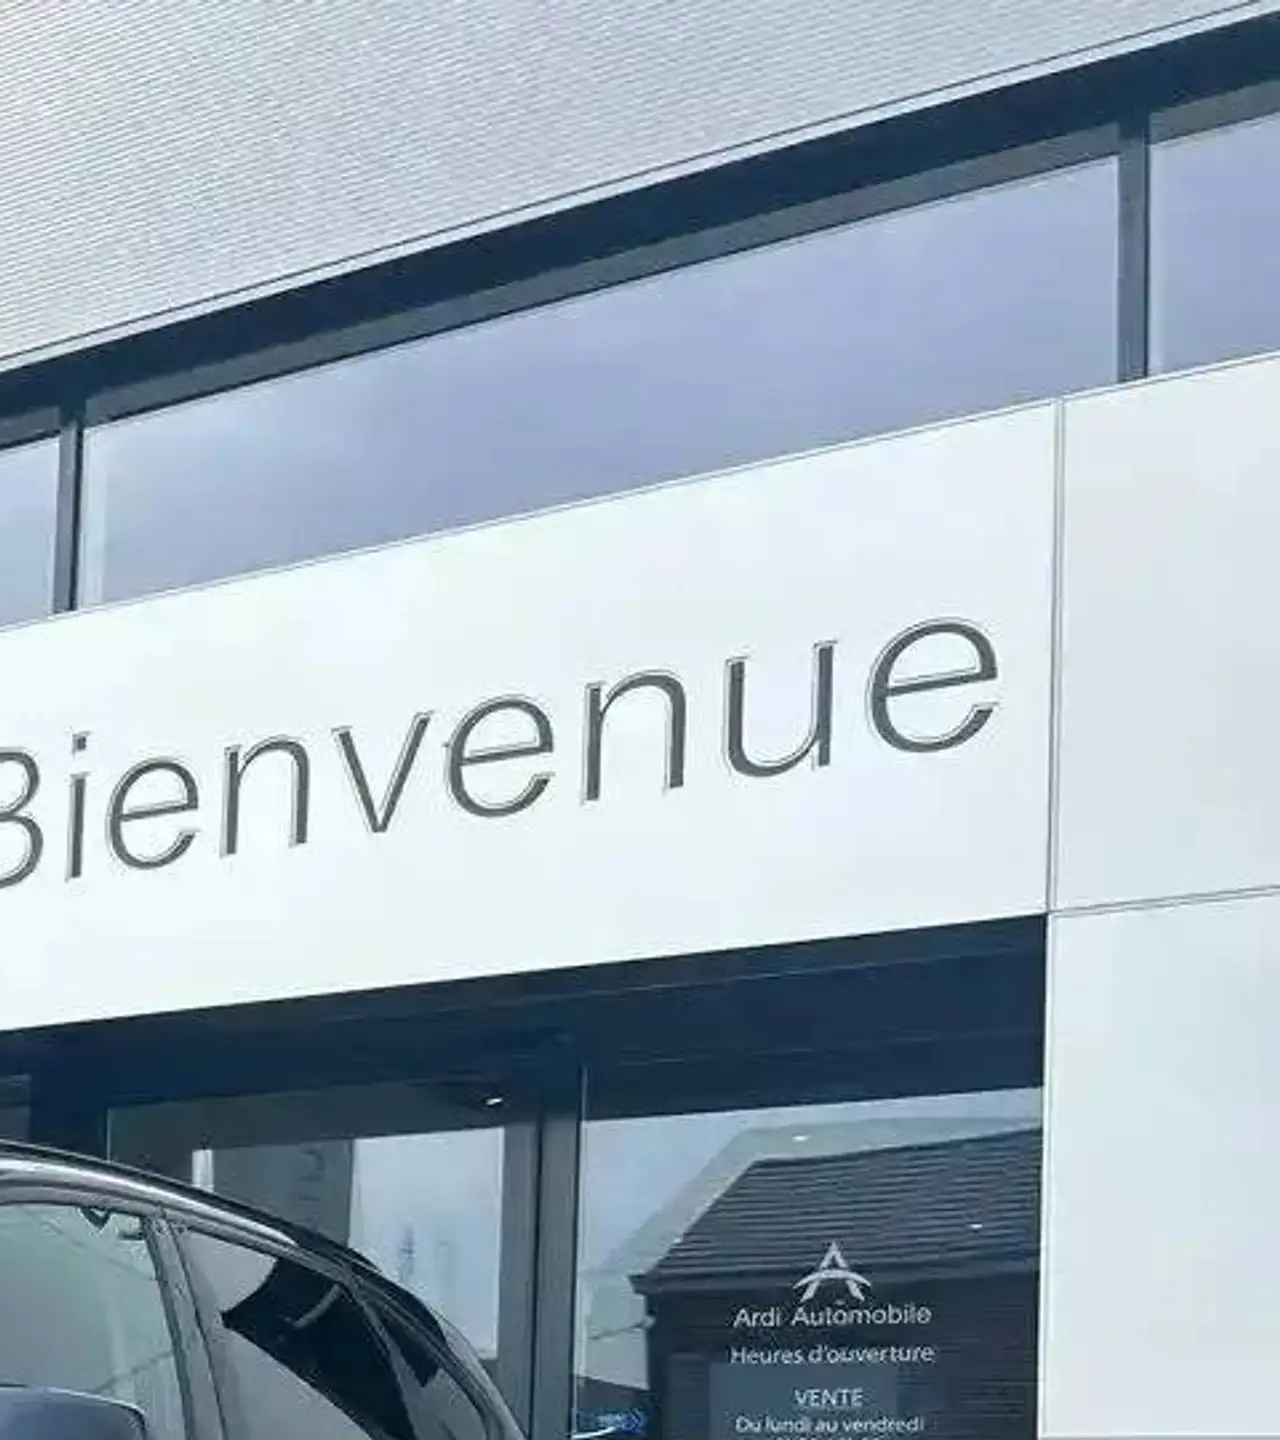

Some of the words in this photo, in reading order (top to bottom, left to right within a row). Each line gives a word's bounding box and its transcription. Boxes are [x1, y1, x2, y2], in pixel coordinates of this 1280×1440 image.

[733, 1306, 781, 1328] Ardi
[791, 1303, 933, 1327] Automobile
[730, 1346, 804, 1365] Heures
[808, 1344, 936, 1364] d'ouverture
[794, 1387, 864, 1408] VENTE
[735, 1415, 762, 1433] Du
[765, 1415, 811, 1433] lundi
[815, 1420, 838, 1433] au
[842, 1415, 925, 1433] vendredi
